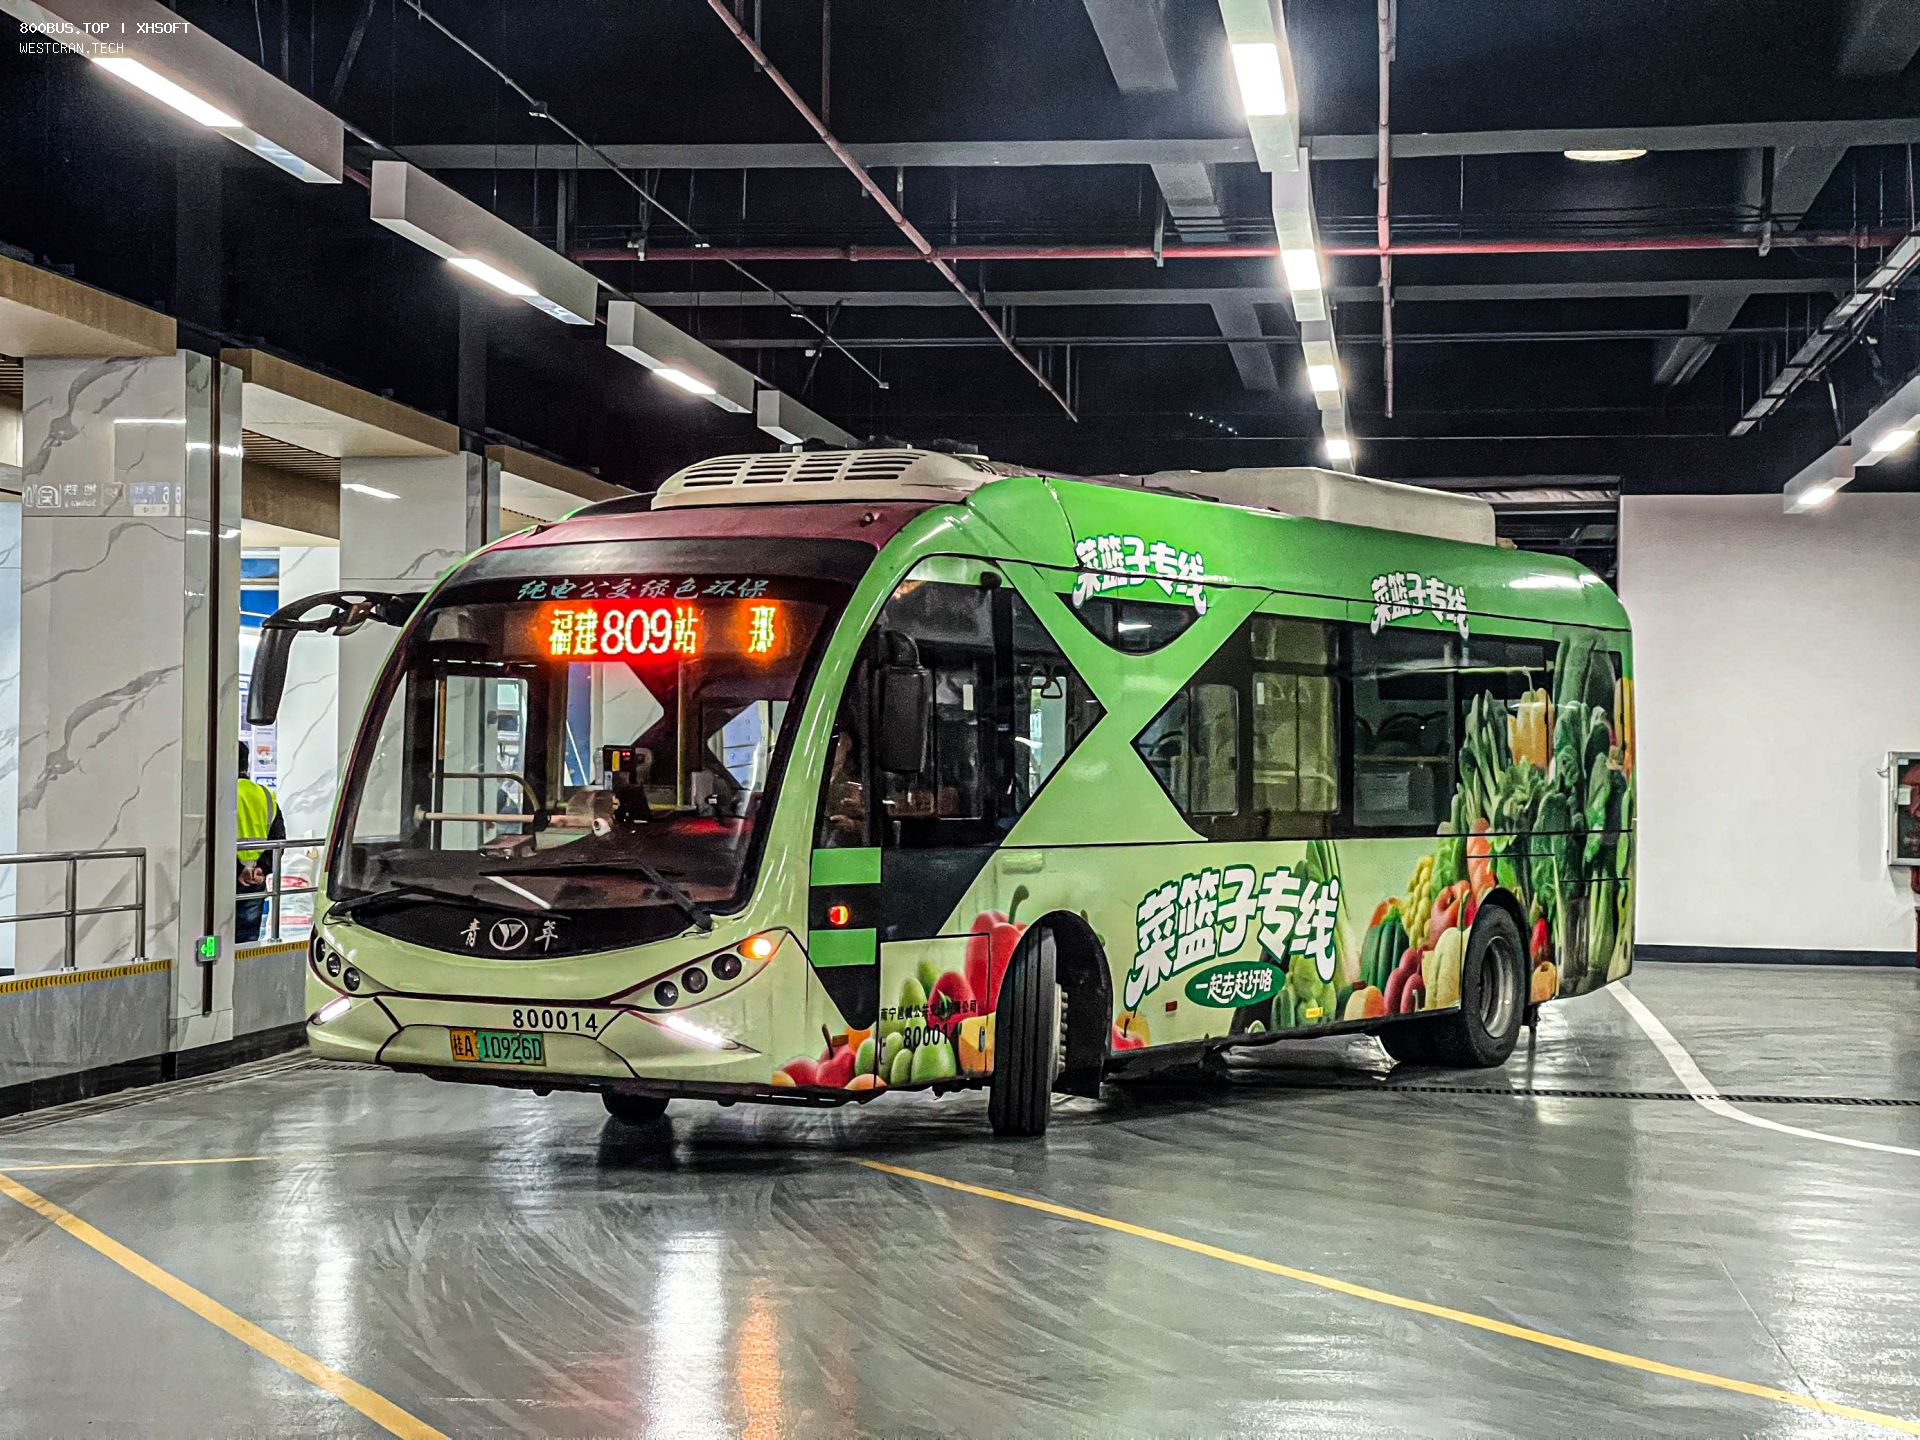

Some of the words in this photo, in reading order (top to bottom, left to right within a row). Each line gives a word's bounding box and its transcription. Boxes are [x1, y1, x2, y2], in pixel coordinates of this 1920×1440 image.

[1072, 535, 1207, 615] 菜篮子专线
[1370, 571, 1470, 640] 菜篮子专线
[1124, 864, 1340, 1010] 菜篮子专线
[512, 1008, 599, 1033] 800014
